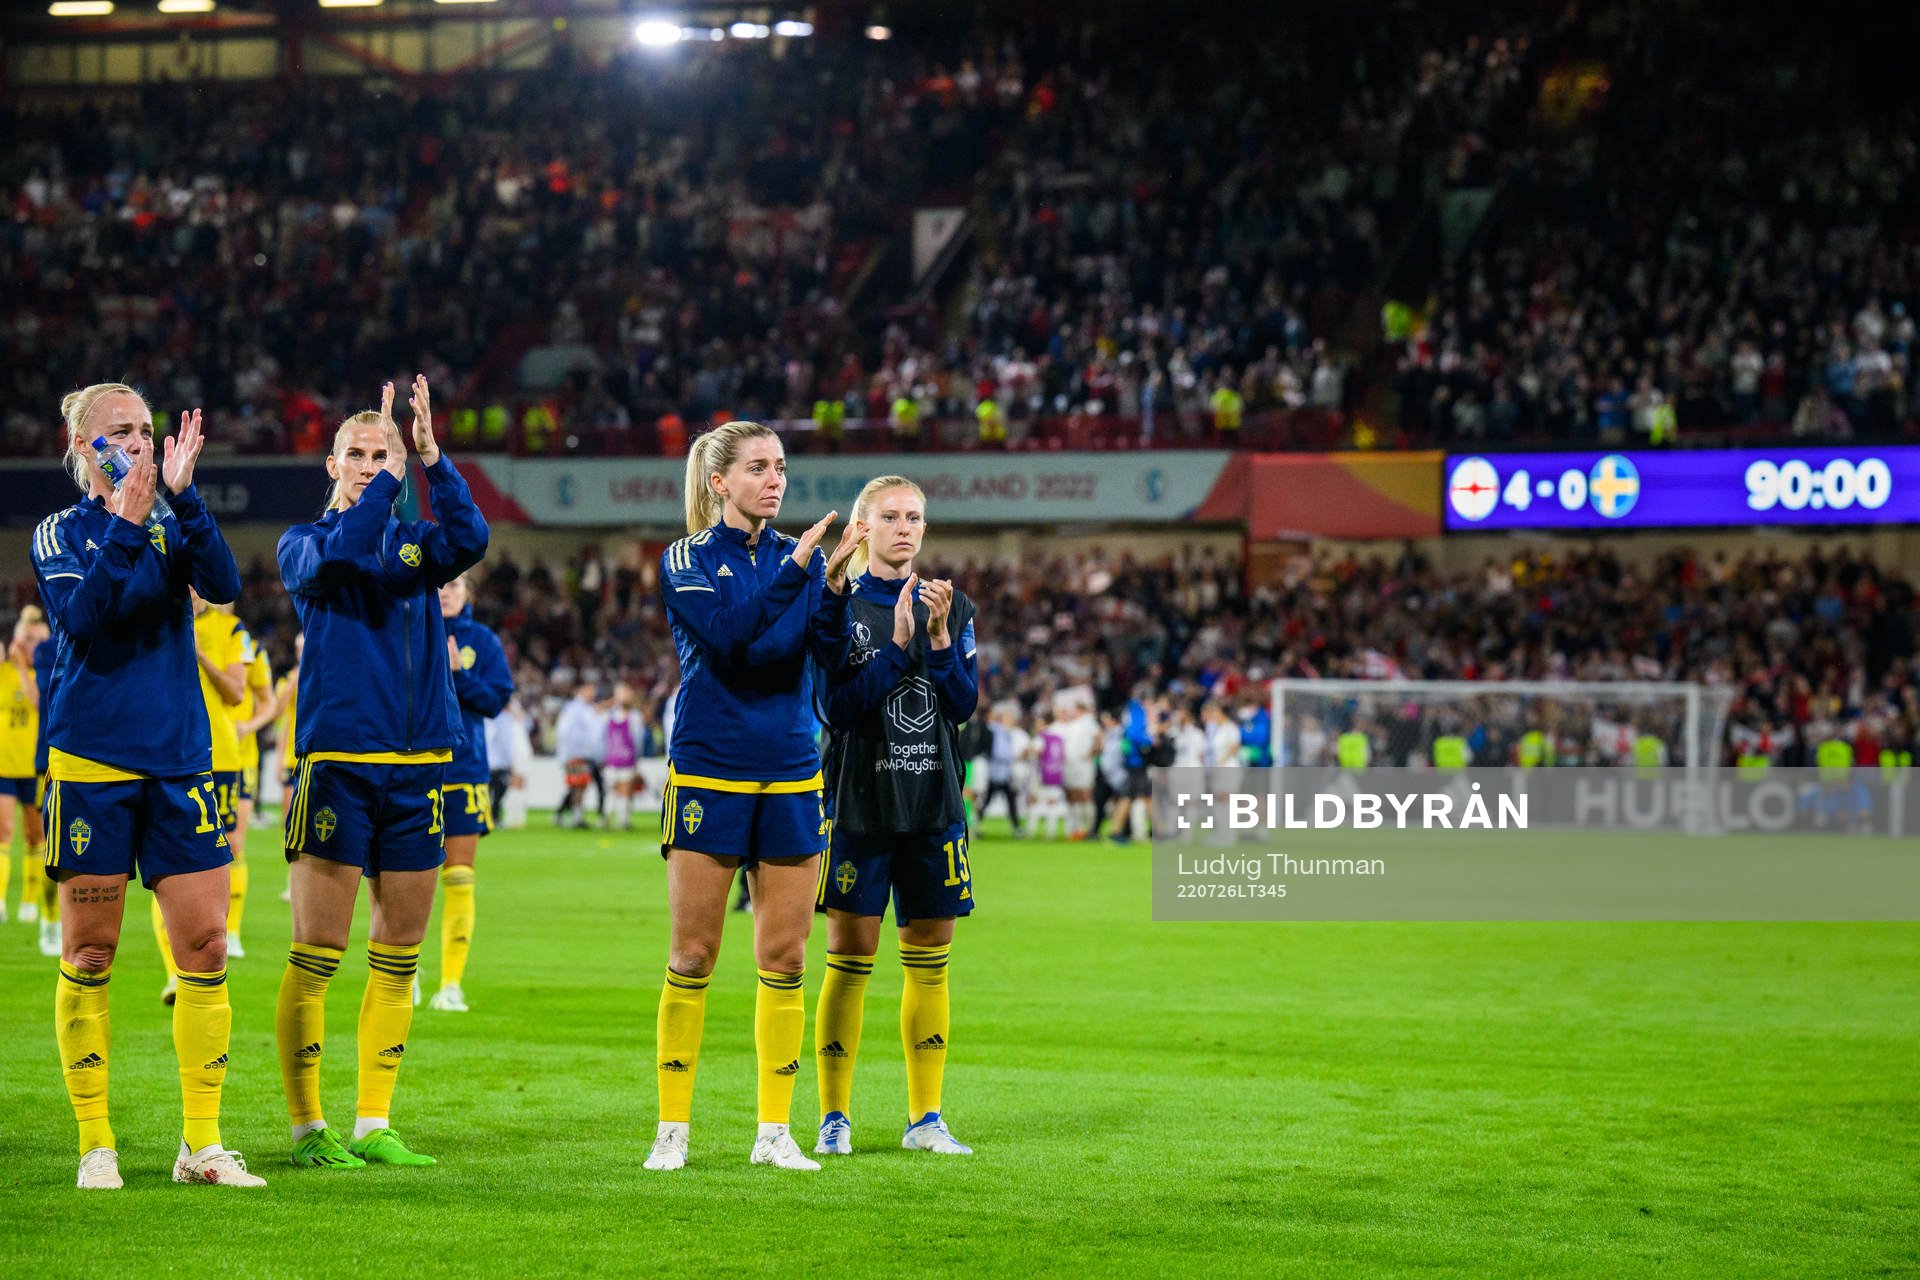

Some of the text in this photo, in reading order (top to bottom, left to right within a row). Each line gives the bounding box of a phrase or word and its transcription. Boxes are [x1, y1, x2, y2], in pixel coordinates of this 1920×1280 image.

[609, 476, 678, 502] UEFA
[921, 476, 1029, 501] NGLAND
[1036, 476, 1097, 501] 2022
[1503, 470, 1532, 511] 4
[1558, 469, 1588, 511] 0
[1745, 458, 1891, 511] 90:00
[890, 741, 939, 758] Together
[187, 781, 222, 834] 17
[1575, 778, 1830, 832] HULO
[943, 837, 970, 887] 15
